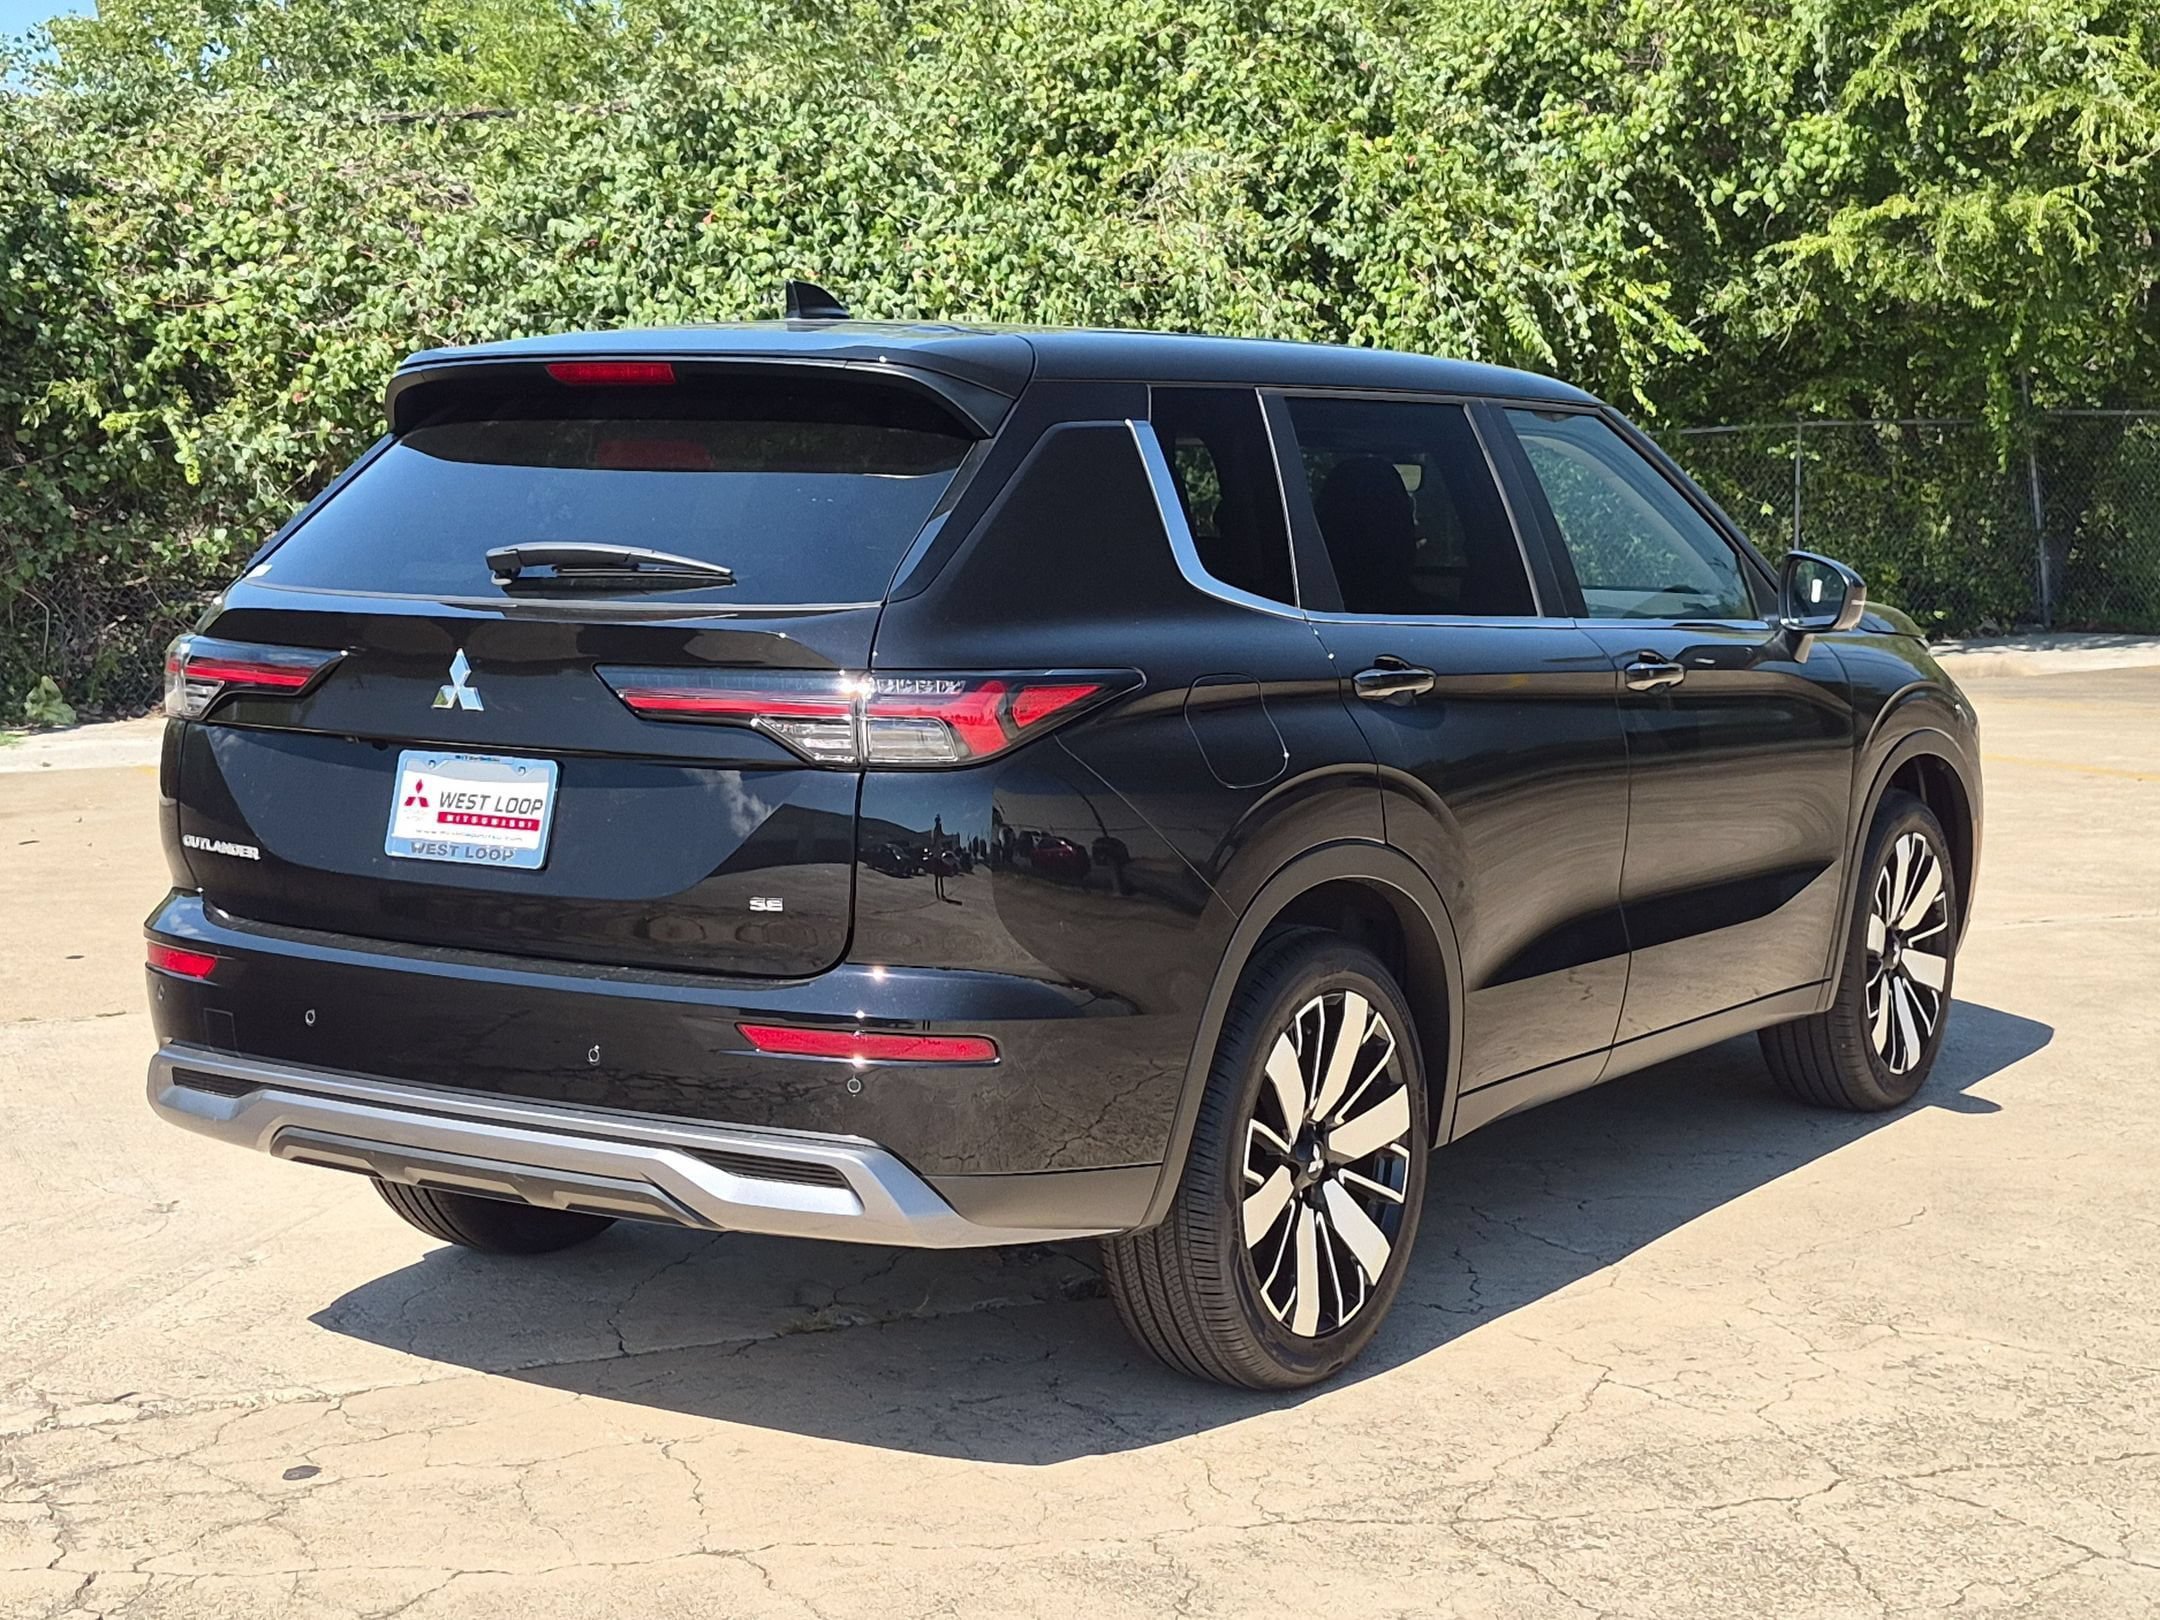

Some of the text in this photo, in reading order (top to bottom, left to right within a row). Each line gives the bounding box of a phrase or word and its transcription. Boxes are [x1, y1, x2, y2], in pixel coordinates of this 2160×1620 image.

[439, 791, 544, 816] WEST LOOP
[182, 834, 261, 860] OUTLANDER
[410, 841, 515, 862] WEST LOOP
[749, 896, 783, 912] SE
